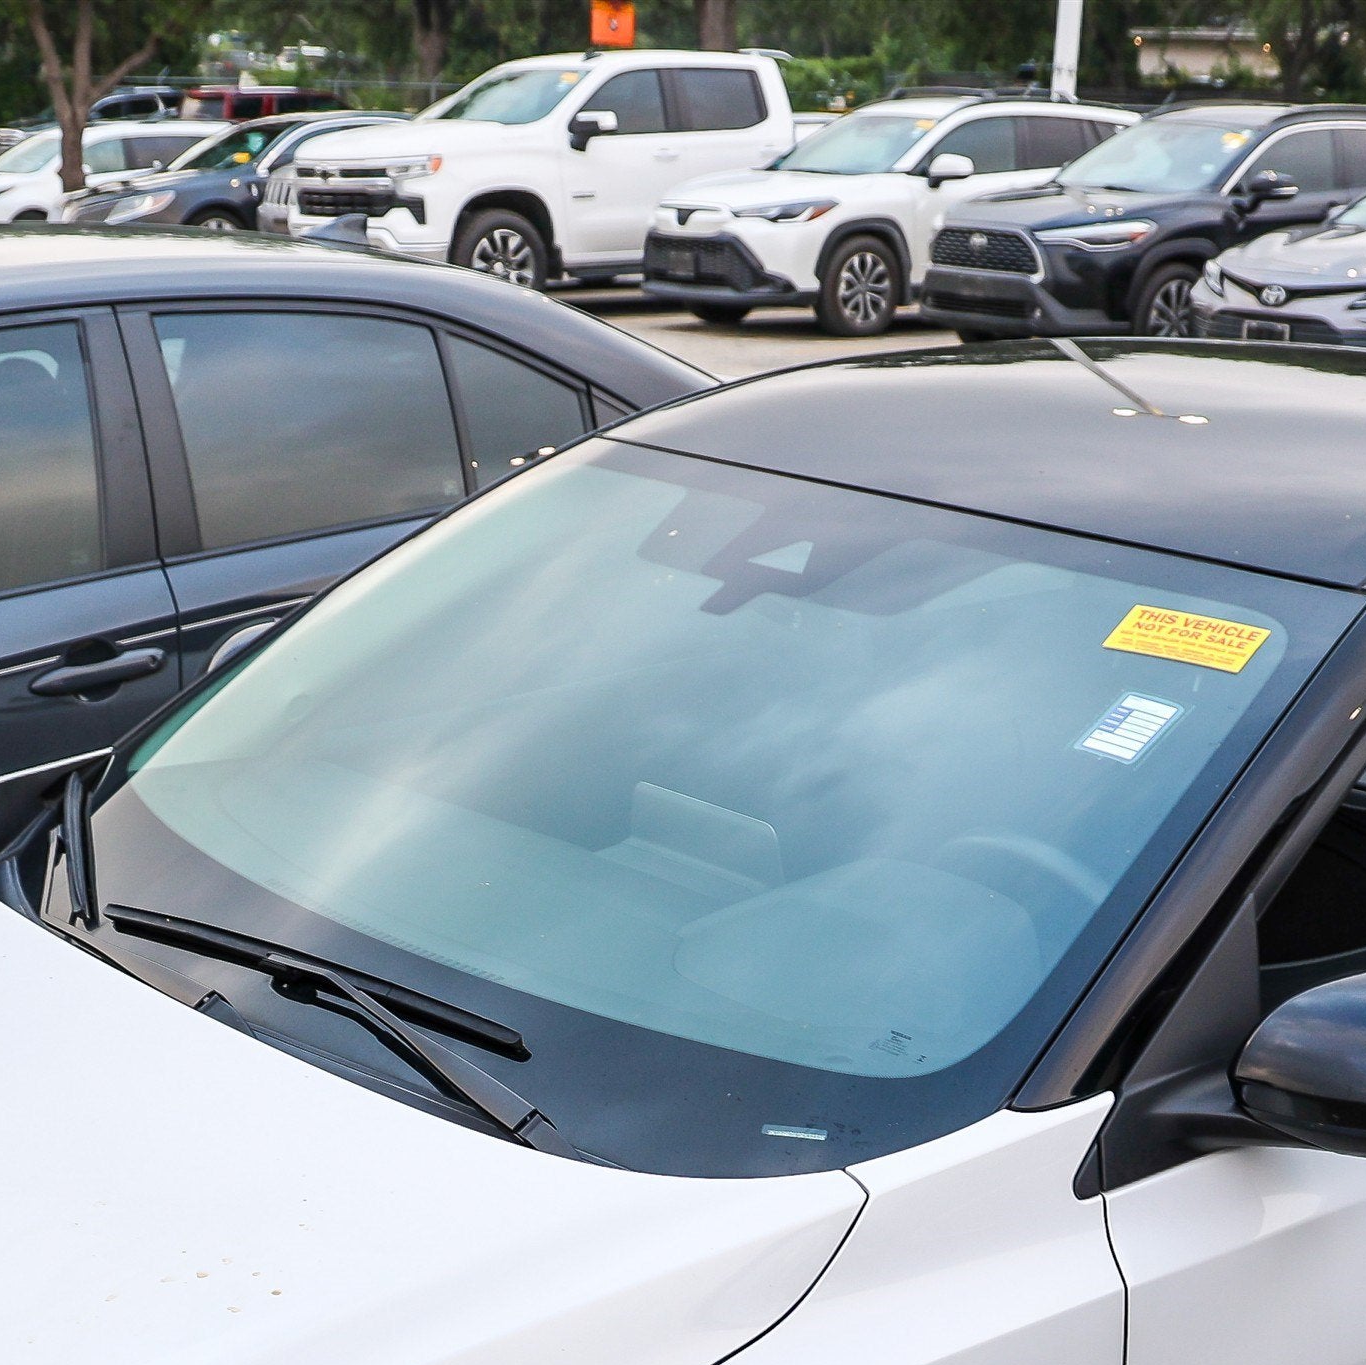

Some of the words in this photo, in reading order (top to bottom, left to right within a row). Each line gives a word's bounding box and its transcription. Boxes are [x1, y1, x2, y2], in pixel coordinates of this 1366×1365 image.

[1133, 621, 1165, 633] NOT
[1168, 628, 1203, 640] FOR
[1206, 636, 1247, 650] SALE
[1138, 610, 1178, 625] THIS
[1184, 617, 1262, 642] VEHICLE
